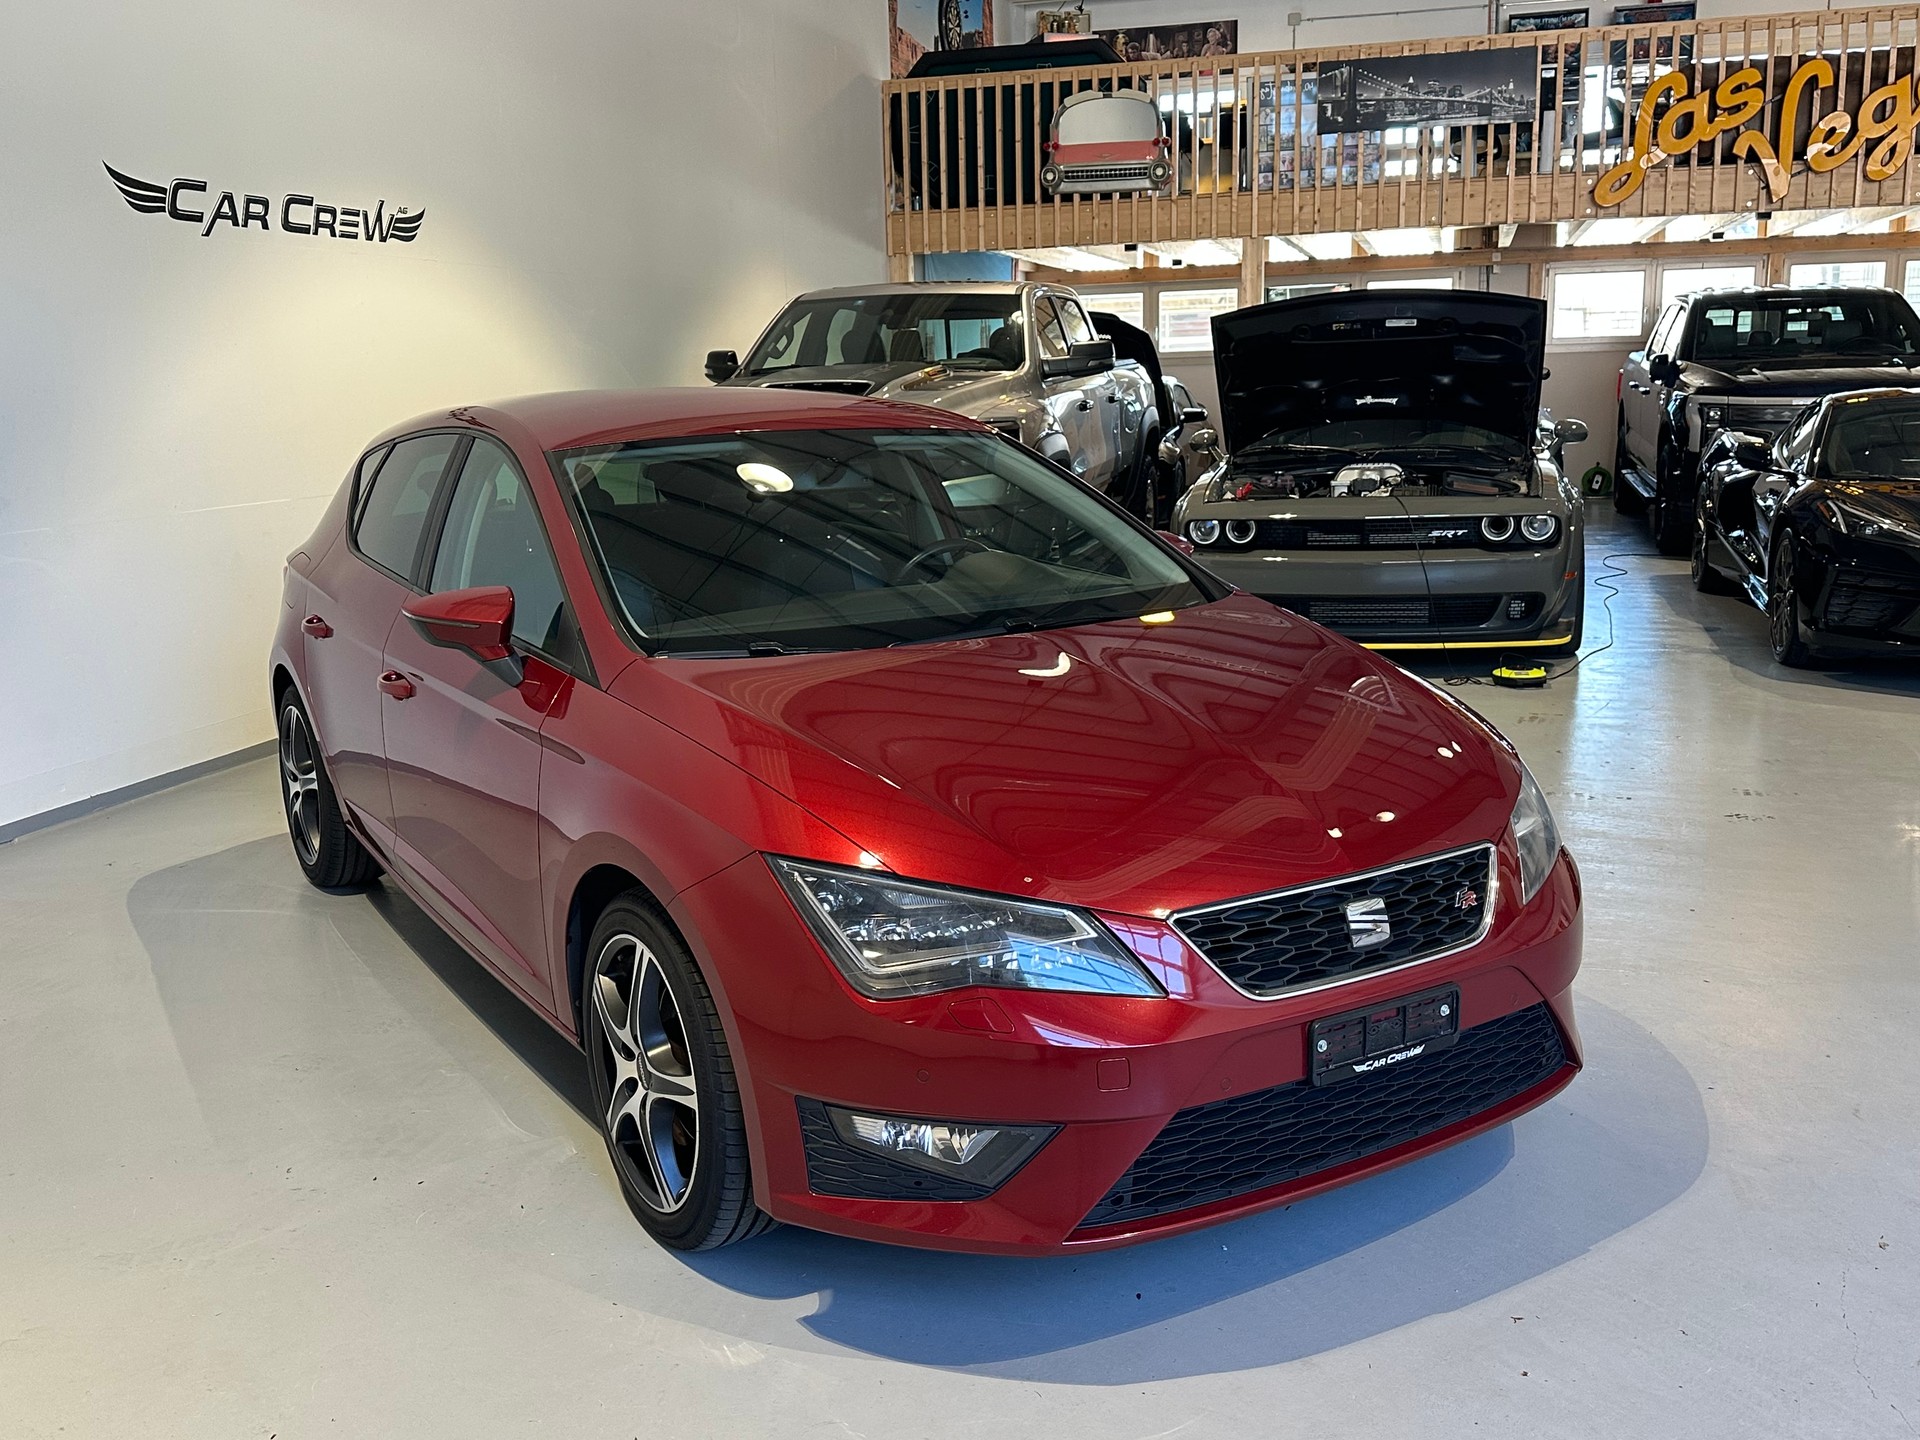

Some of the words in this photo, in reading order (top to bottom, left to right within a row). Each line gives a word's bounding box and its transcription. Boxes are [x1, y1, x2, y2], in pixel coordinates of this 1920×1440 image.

[1593, 67, 1765, 207] Las
[1732, 58, 1920, 203] Veg
[1428, 529, 1468, 538] SRT
[1455, 886, 1478, 909] FR
